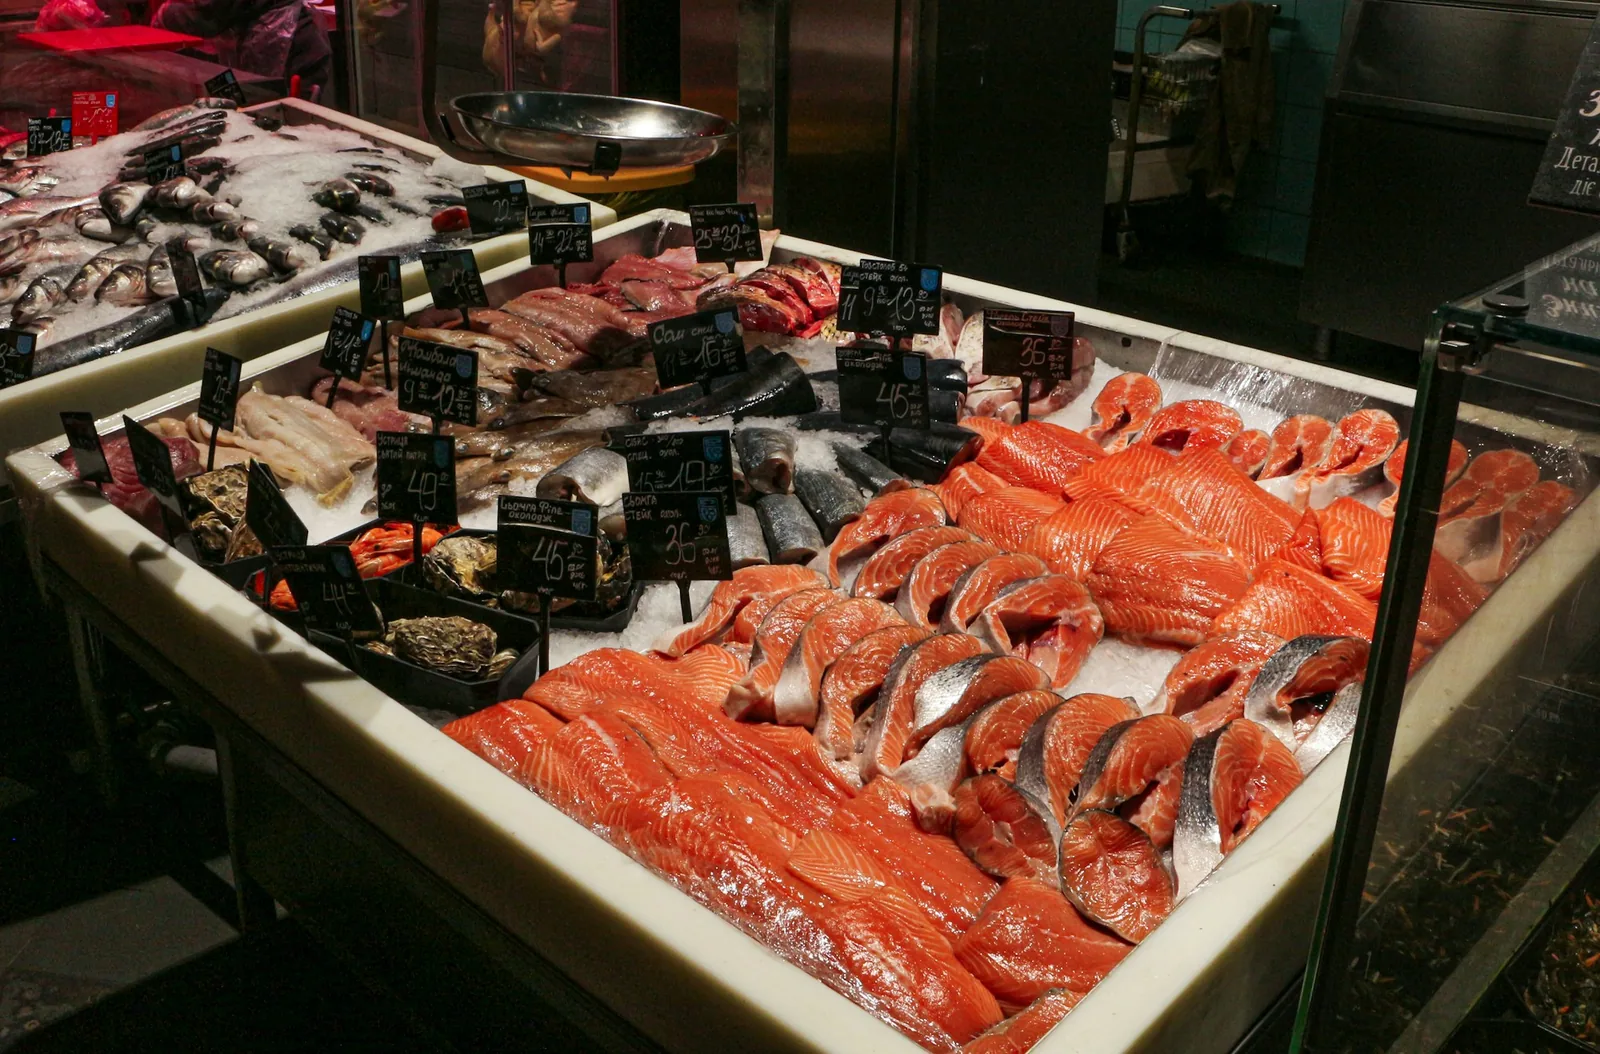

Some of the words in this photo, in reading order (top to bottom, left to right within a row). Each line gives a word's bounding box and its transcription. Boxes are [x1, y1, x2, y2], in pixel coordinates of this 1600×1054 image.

[1019, 337, 1046, 367] 36
[876, 382, 910, 420] 45
[407, 469, 439, 512] 49
[531, 536, 569, 582] 45
[664, 521, 697, 566] 36
